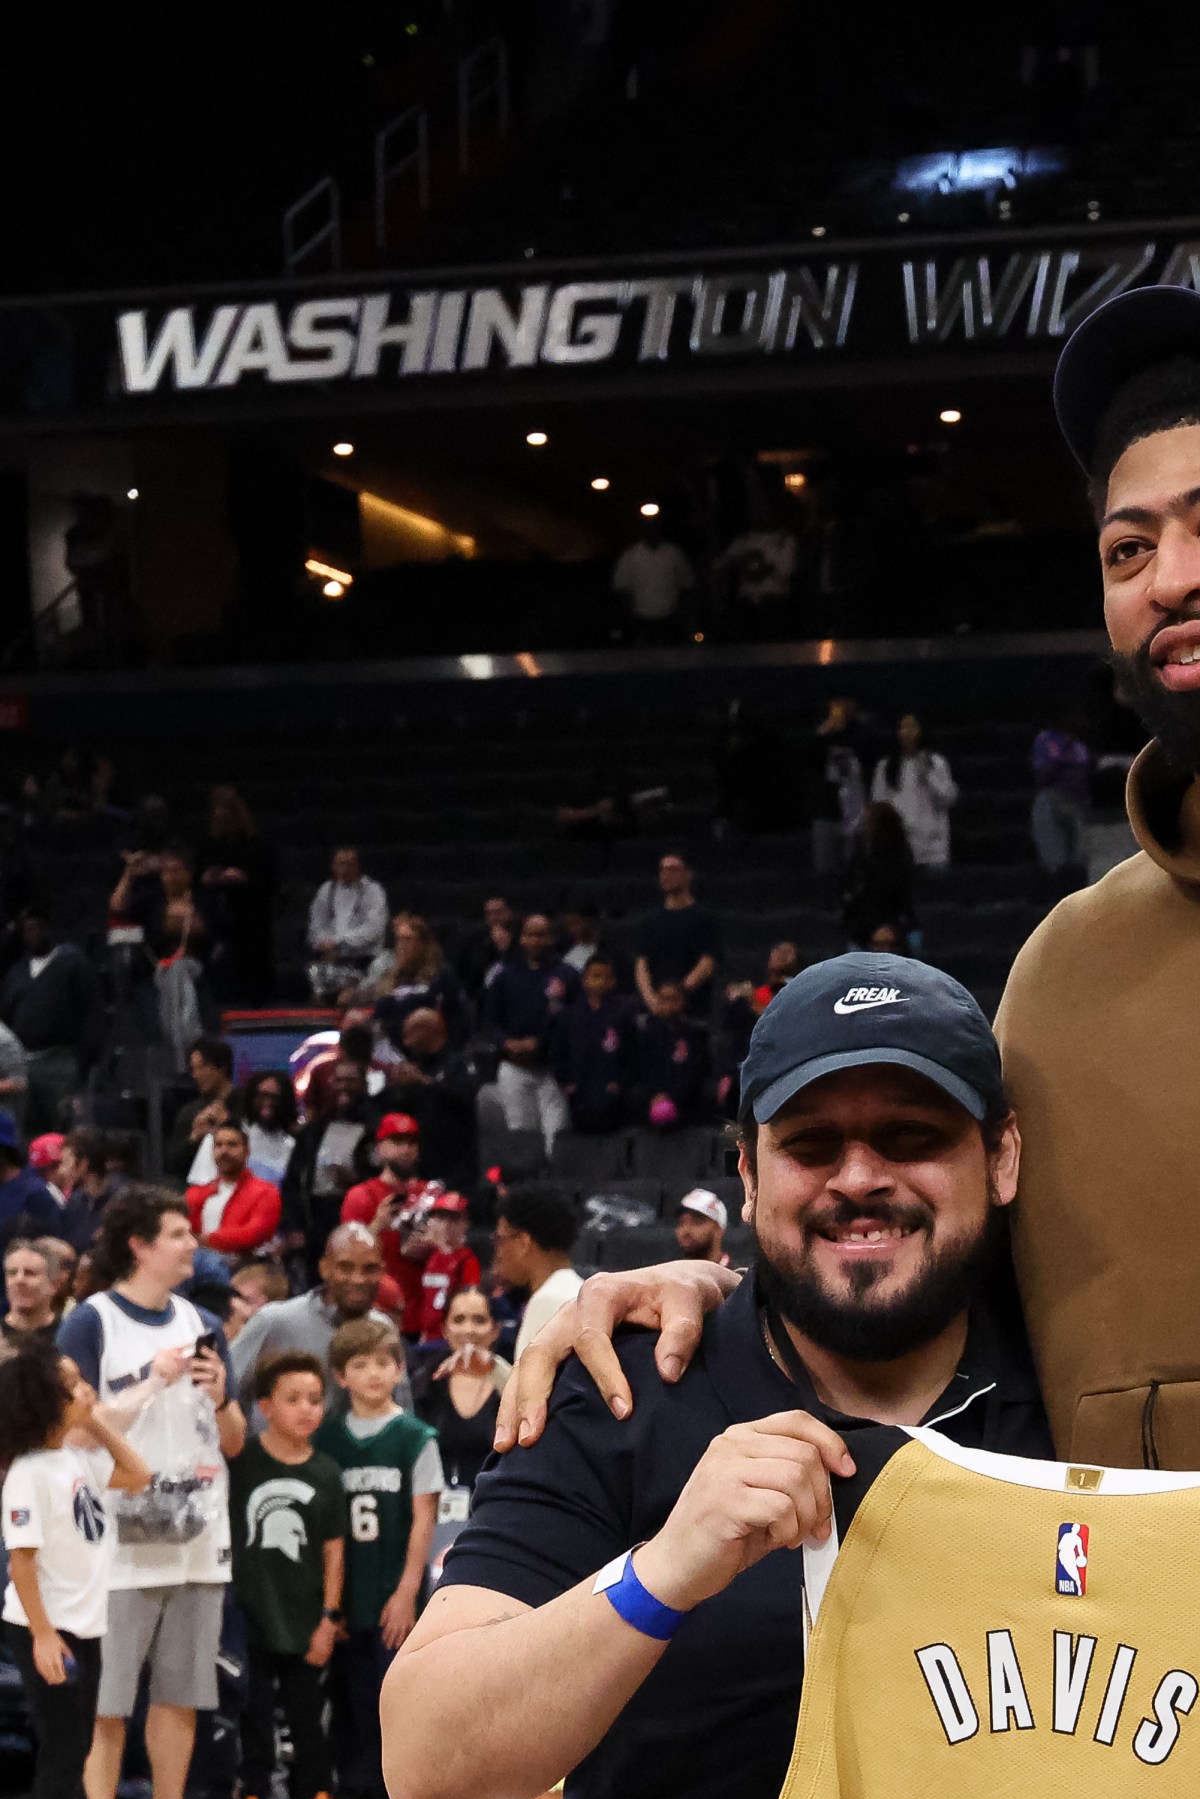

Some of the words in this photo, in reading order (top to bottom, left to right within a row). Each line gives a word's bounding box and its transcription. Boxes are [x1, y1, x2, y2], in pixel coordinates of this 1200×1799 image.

[117, 260, 860, 394] WASHINGTON
[843, 987, 901, 1002] FREAK
[1079, 1472, 1086, 1486] 1
[350, 1494, 379, 1541] 6
[1059, 1579, 1075, 1593] NBA
[914, 1629, 1199, 1765] DAVIS
